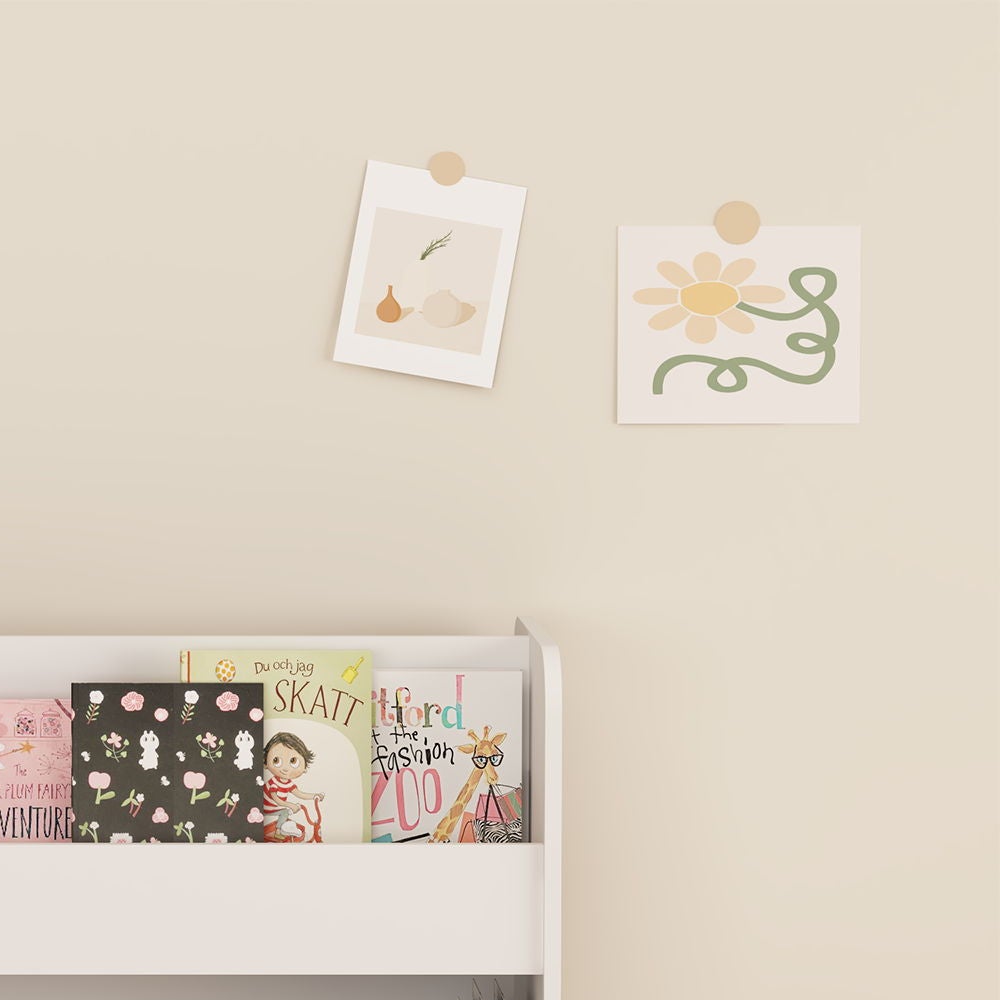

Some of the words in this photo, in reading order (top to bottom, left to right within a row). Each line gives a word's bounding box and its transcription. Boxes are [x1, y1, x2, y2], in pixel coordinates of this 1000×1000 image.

[254, 661, 271, 674] Du
[272, 658, 293, 670] och
[289, 659, 314, 677] jag
[273, 678, 364, 727] SKATT
[390, 725, 419, 745] the
[14, 763, 27, 776] The
[5, 783, 34, 800] PLUM
